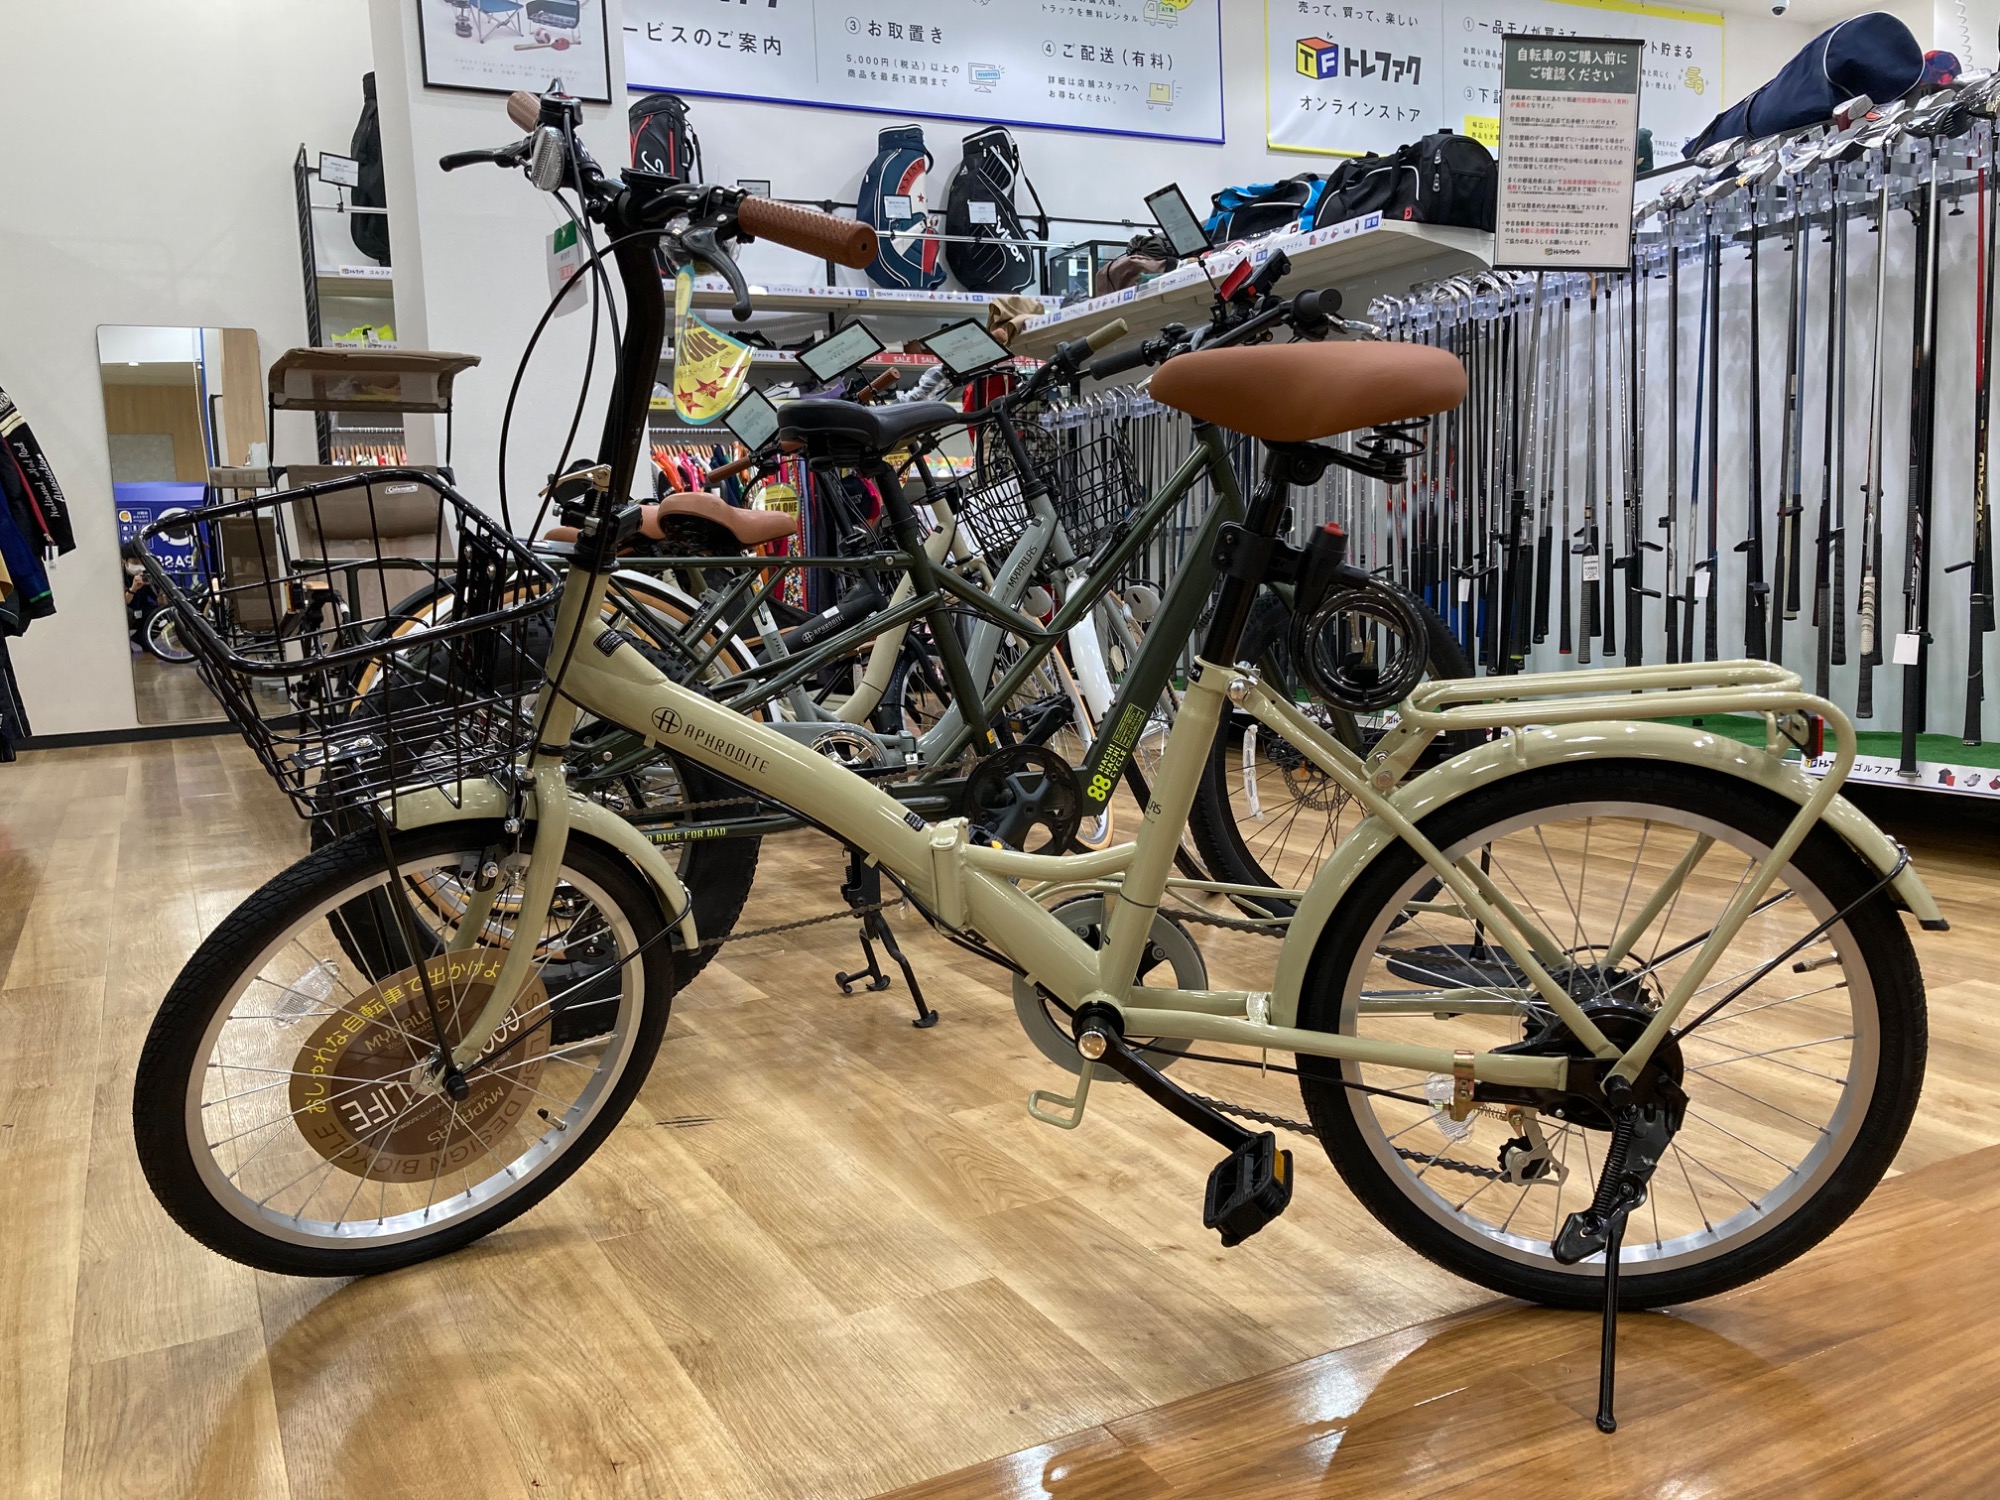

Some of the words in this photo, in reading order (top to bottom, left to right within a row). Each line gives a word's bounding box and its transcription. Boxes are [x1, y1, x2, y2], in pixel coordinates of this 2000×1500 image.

[1042, 4, 1139, 23] トラックを無料レンタル
[1298, 1, 1419, 27] 売って、買って、楽しい
[868, 19, 944, 44] お取置き
[1517, 47, 1627, 65] 自転車のご購入前に
[847, 68, 948, 88] 商品を最長1週間まで
[1344, 57, 1422, 85] トレファク
[1529, 67, 1615, 82] ご確認ください
[1048, 75, 1140, 93] 詳細は店舗スタッフへ
[1048, 89, 1117, 105] お尋ねください。
[1299, 96, 1422, 122] オンラインストア
[1653, 149, 1678, 158] FASHION
[1655, 140, 1678, 148] TREFAC
[1007, 544, 1038, 588] MYPALLAS
[813, 614, 846, 635] APHRODITE
[684, 723, 770, 774] APHRODITE
[1097, 743, 1116, 772] HACHI
[1103, 746, 1122, 775] HACHI
[1109, 749, 1127, 778] CYCLE
[1087, 774, 1111, 802] 88
[656, 831, 681, 842] BIKE
[684, 829, 704, 839] FOR
[706, 827, 726, 837] DAD
[340, 1080, 413, 1133] LIFE
